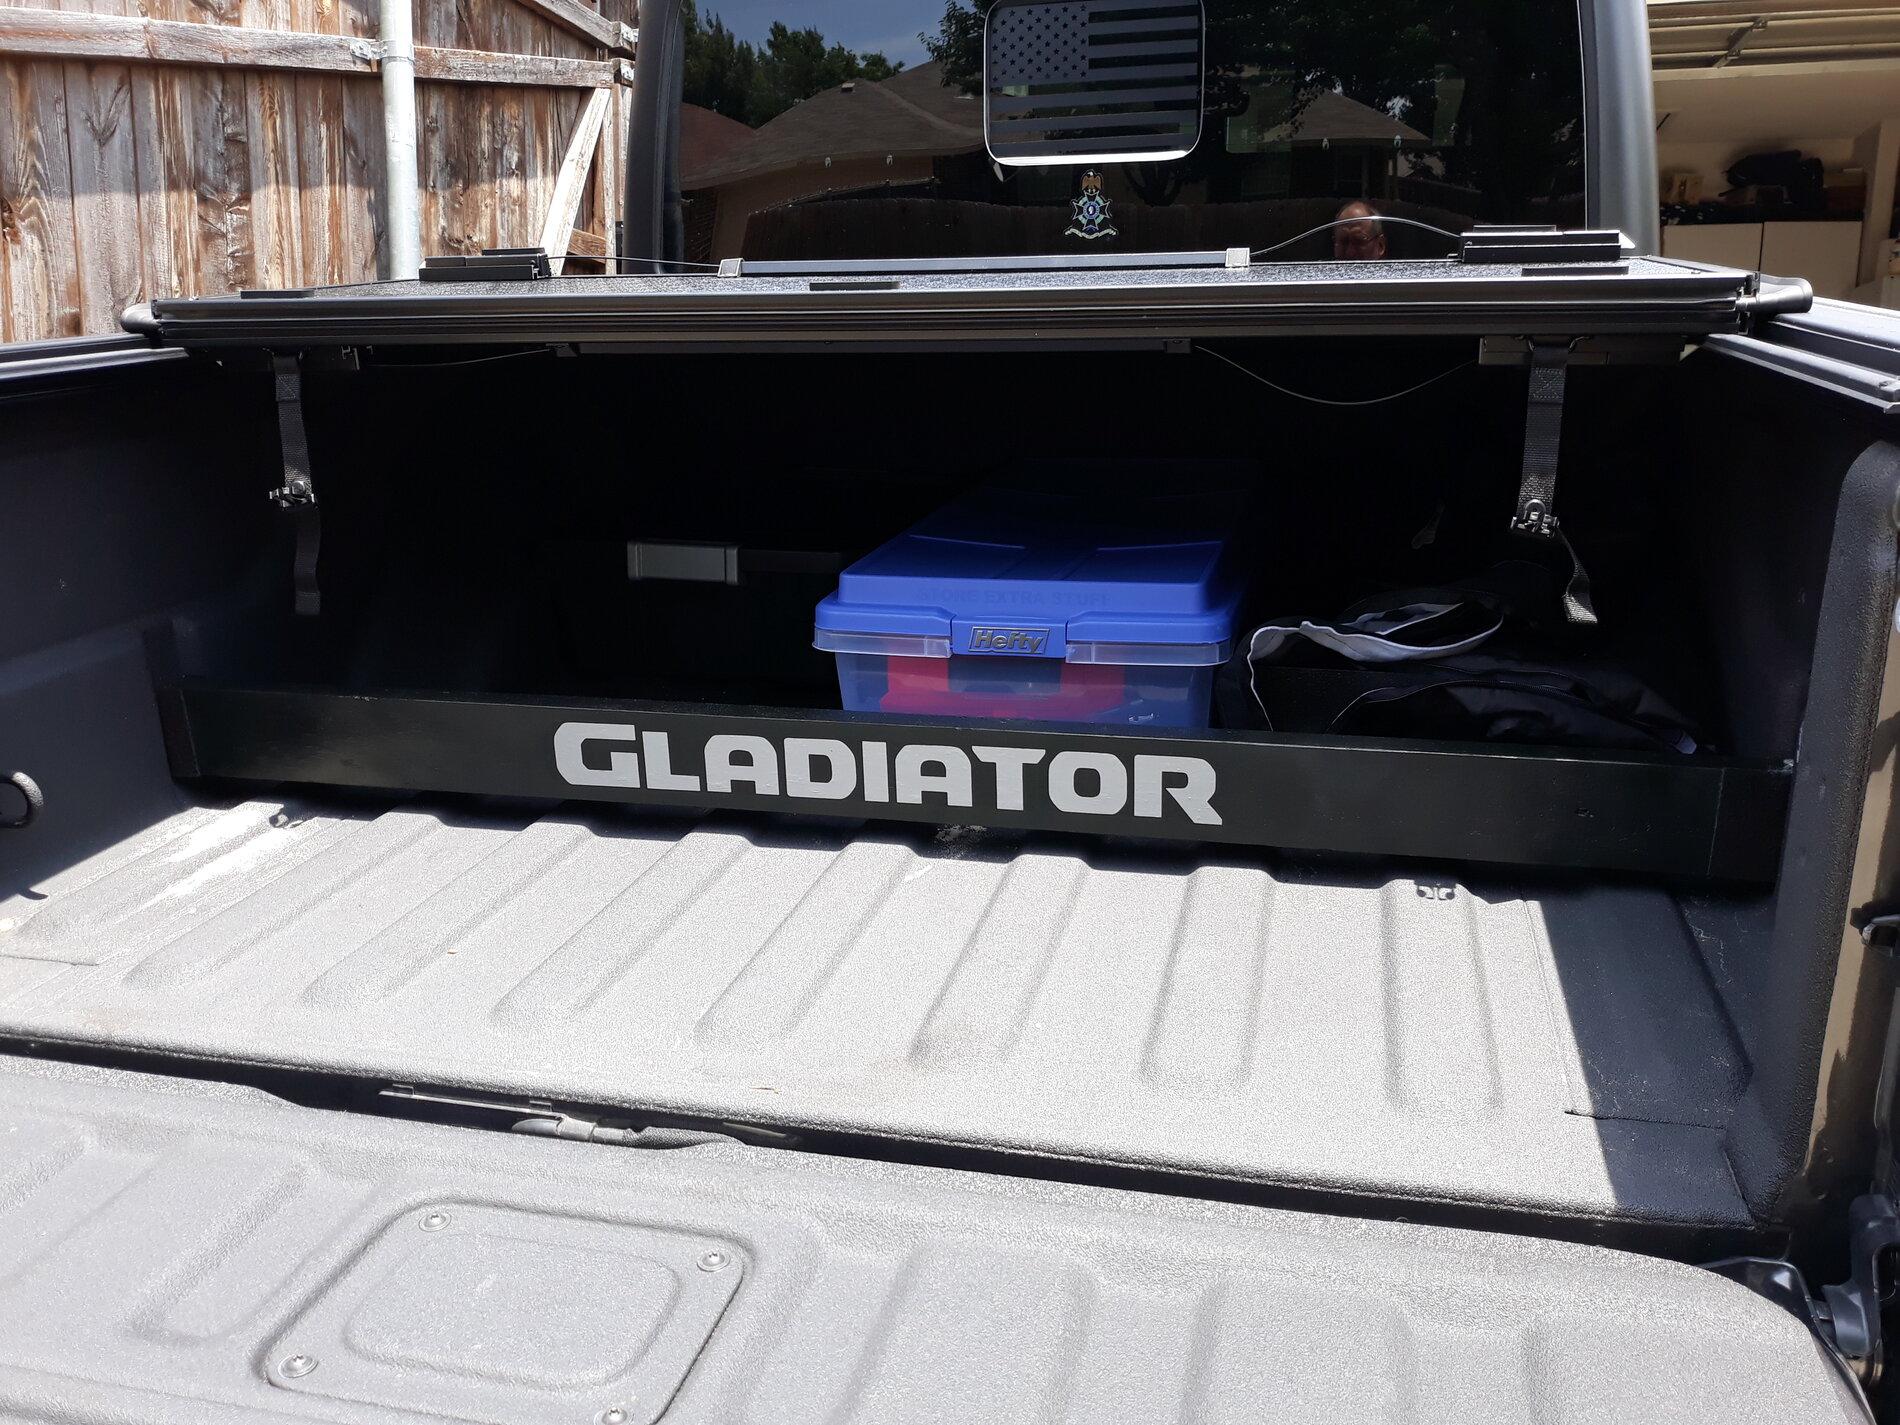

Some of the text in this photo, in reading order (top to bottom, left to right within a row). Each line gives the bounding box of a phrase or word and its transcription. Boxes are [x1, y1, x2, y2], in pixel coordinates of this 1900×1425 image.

[984, 589, 1045, 606] EXTRA
[1052, 592, 1112, 607] STUFF
[974, 629, 1044, 654] Hefty
[553, 721, 1223, 826] GLADIATOR
